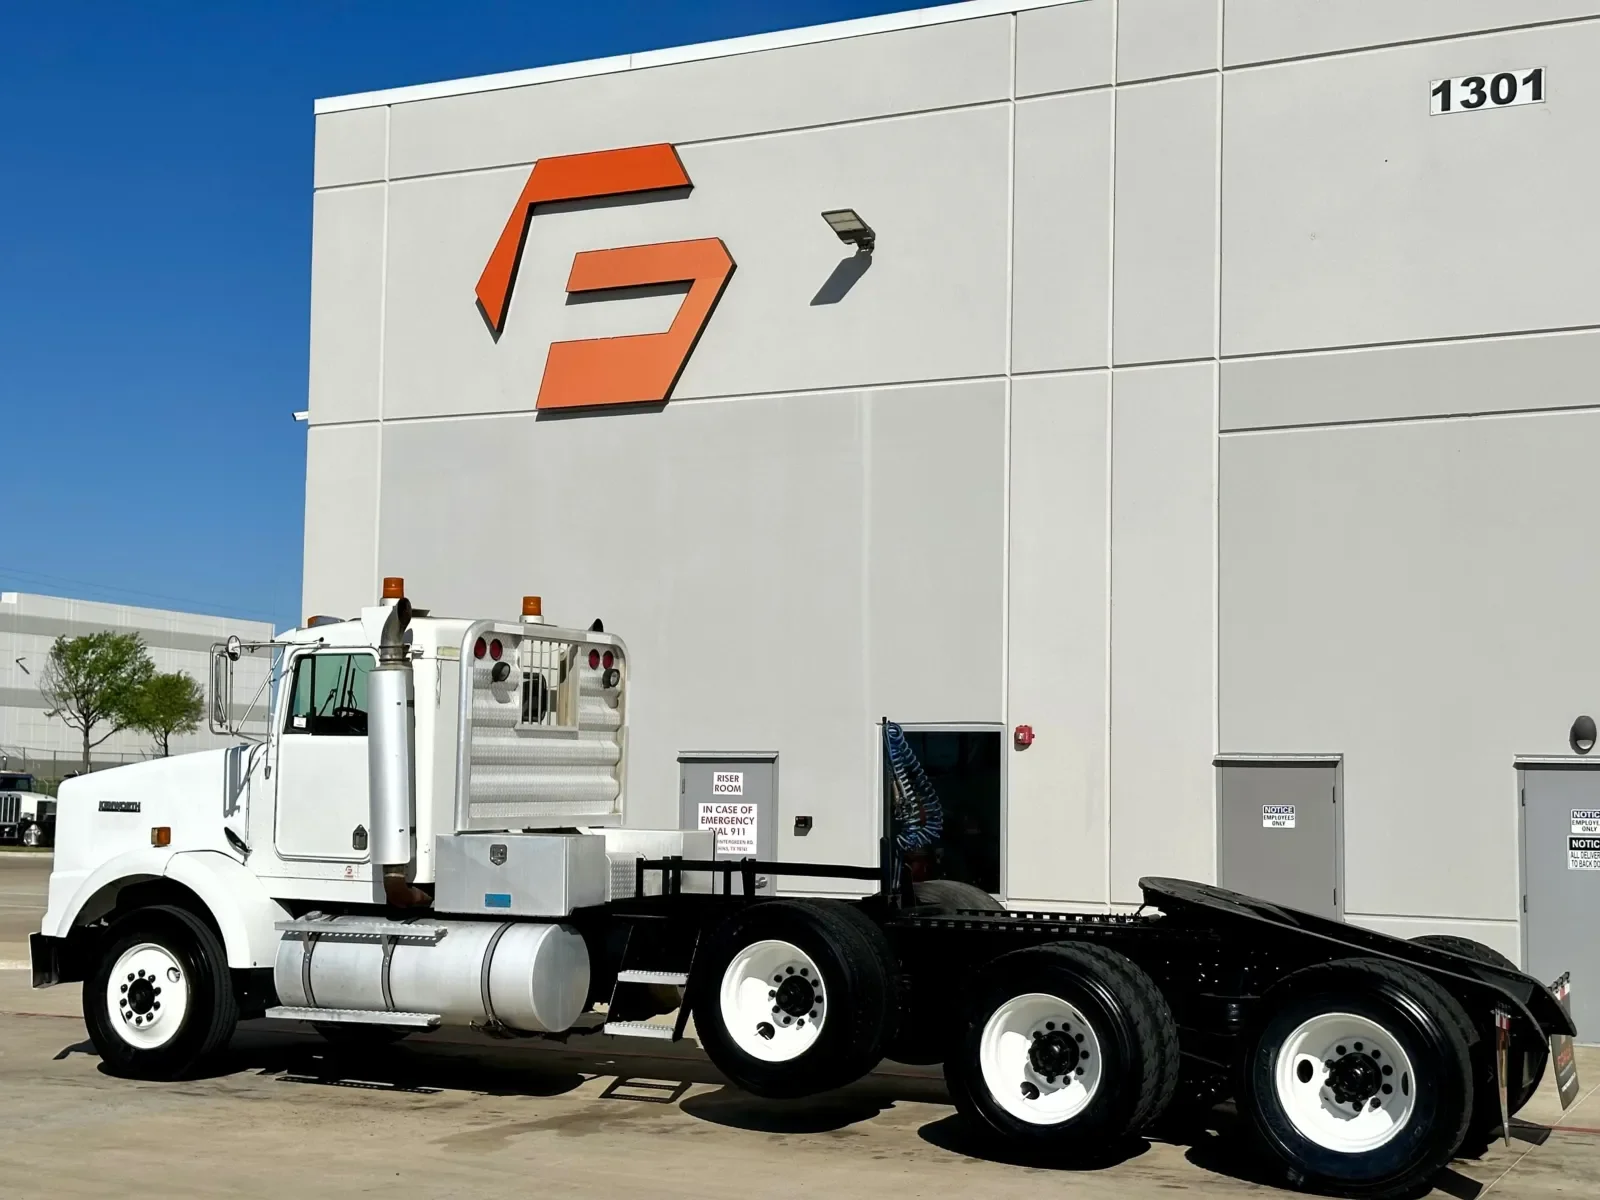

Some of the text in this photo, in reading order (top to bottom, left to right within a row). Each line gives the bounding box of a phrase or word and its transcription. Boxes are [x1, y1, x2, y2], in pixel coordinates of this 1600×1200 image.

[1432, 68, 1542, 112] 1301
[717, 774, 740, 783] RISER
[714, 784, 742, 793] ROOM
[702, 805, 753, 815] IN CASE OF
[1264, 806, 1294, 814] NOTICE
[700, 816, 755, 826] EMERGENCY
[730, 827, 746, 836] 911
[1571, 839, 1600, 849] NOTIC
[1570, 851, 1600, 859] ALL DELIVER
[1571, 859, 1578, 867] TO
[1579, 859, 1593, 868] BACK
